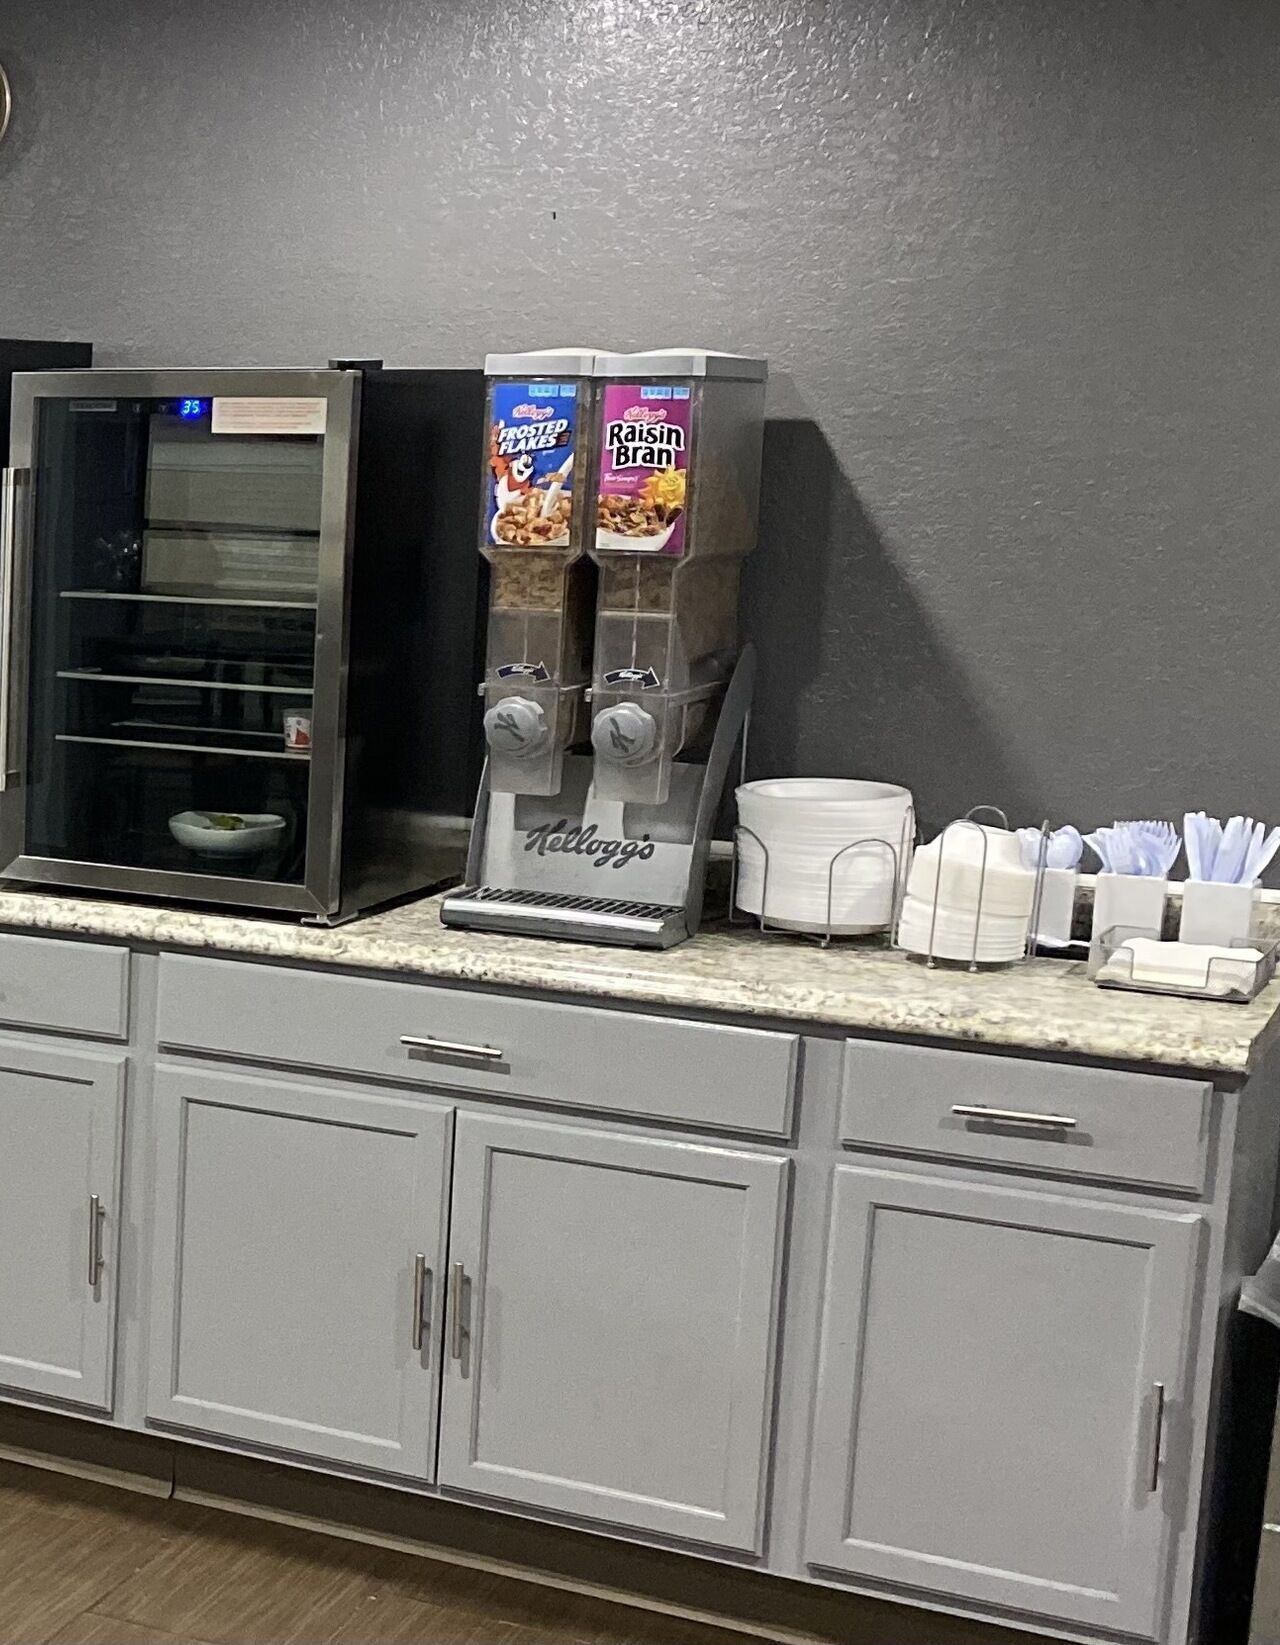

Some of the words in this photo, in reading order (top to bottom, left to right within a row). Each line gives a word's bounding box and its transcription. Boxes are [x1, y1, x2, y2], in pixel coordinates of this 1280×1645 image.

[182, 400, 200, 414] 35
[498, 419, 568, 442] FROSTED
[609, 422, 682, 450] Raisin
[499, 433, 557, 456] FLAKES
[615, 446, 672, 468] Bran
[524, 819, 655, 868] Kellogg's
